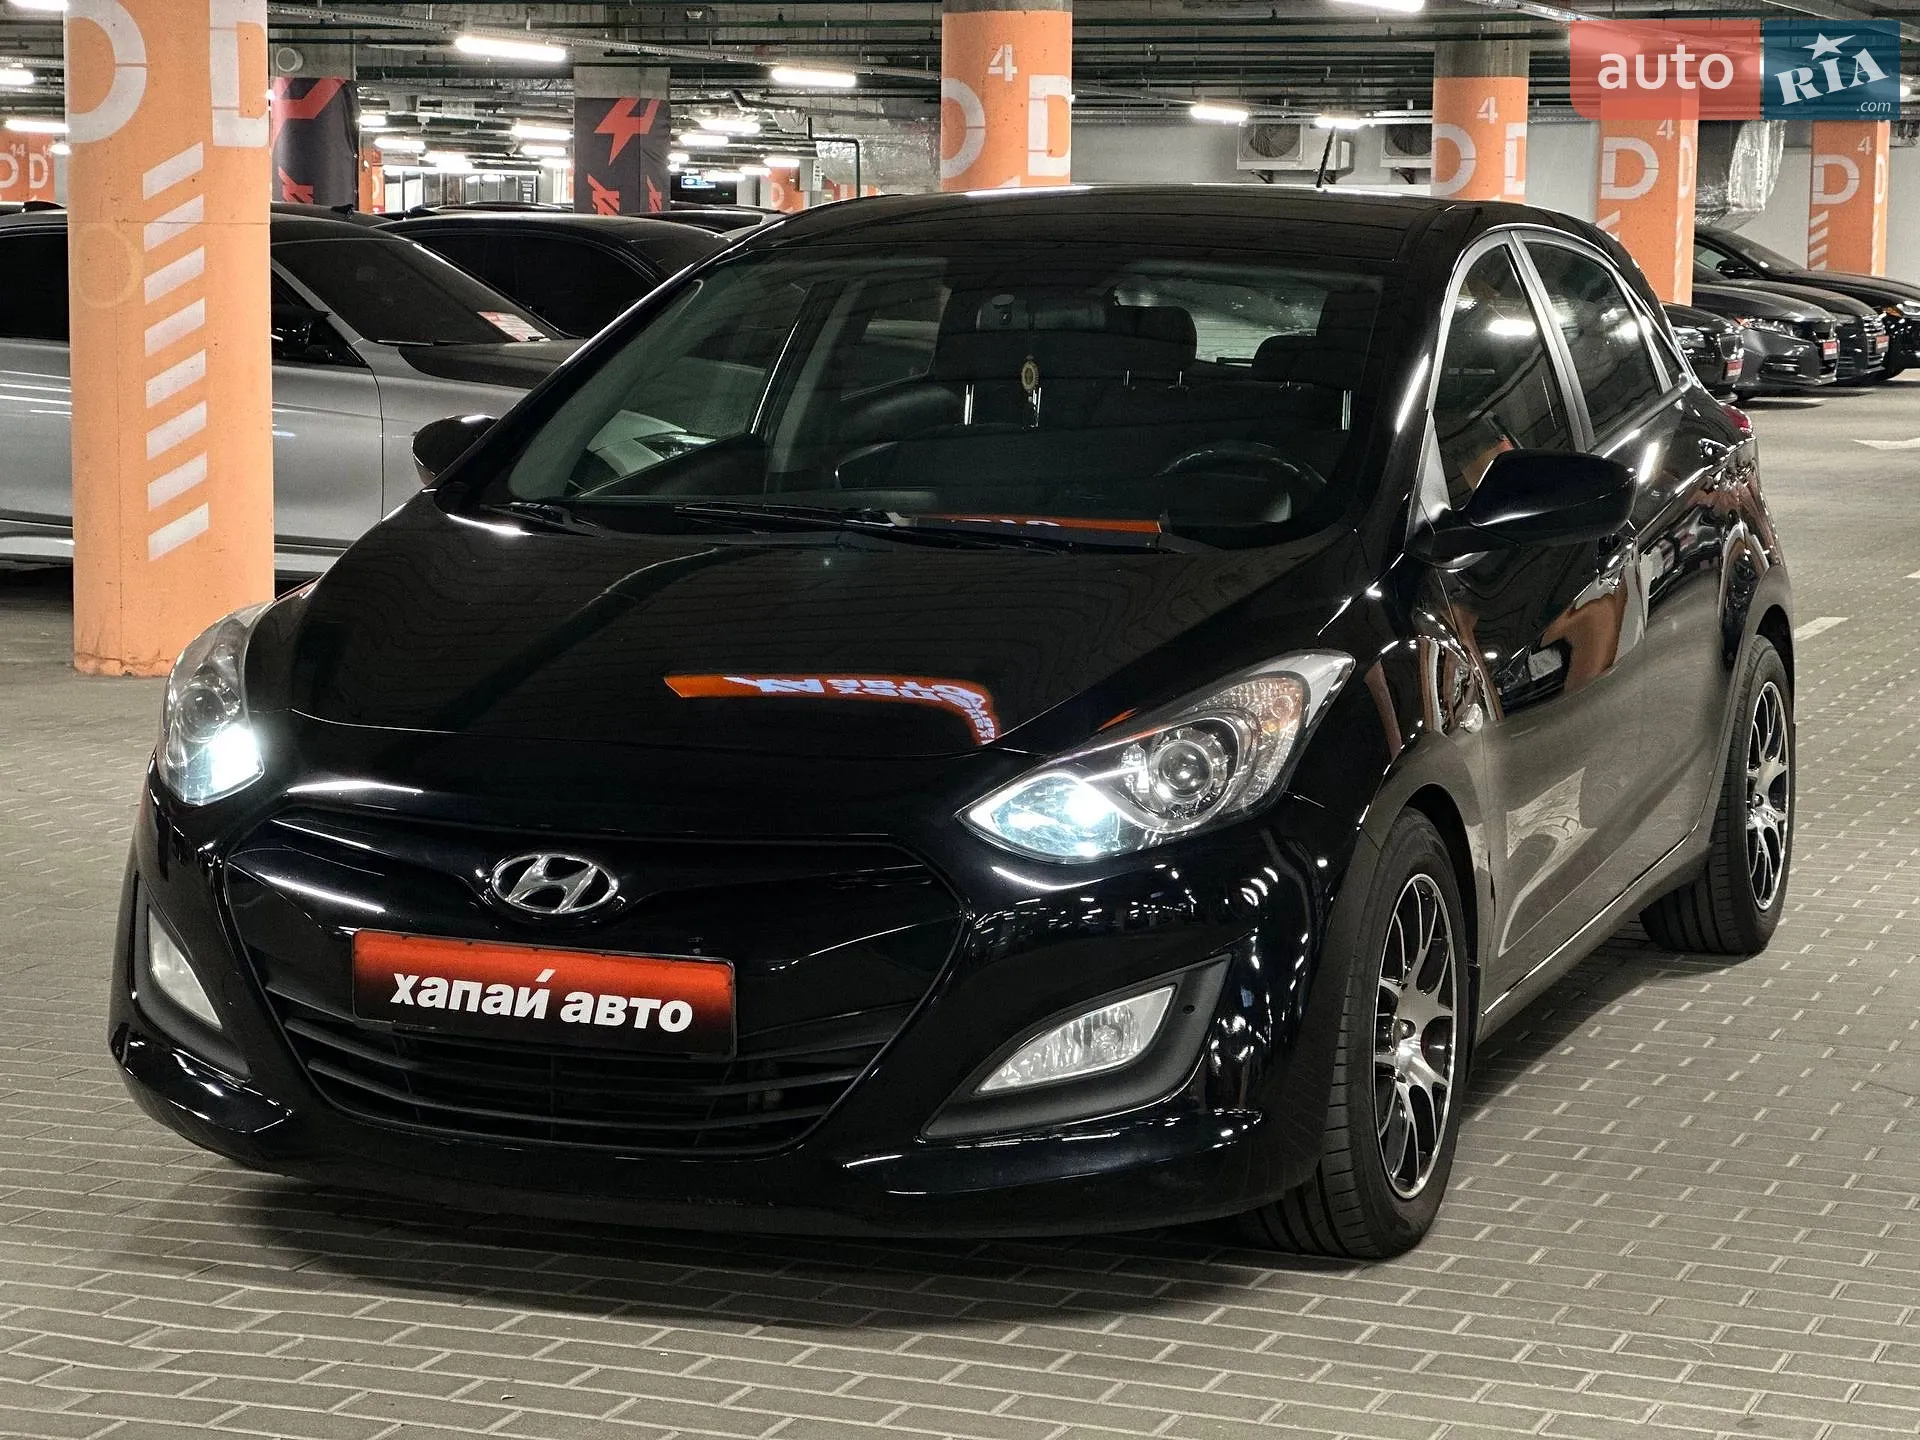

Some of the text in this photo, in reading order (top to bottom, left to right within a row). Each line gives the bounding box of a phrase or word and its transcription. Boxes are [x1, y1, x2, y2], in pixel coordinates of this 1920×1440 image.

[988, 44, 1018, 81] 4
[1476, 96, 1498, 124] 4
[1656, 118, 1674, 140] 4
[1857, 136, 1872, 155] 4
[29, 152, 48, 189] D
[1601, 136, 1659, 199] D
[1812, 154, 1860, 205] D
[560, 990, 693, 1033] авто
